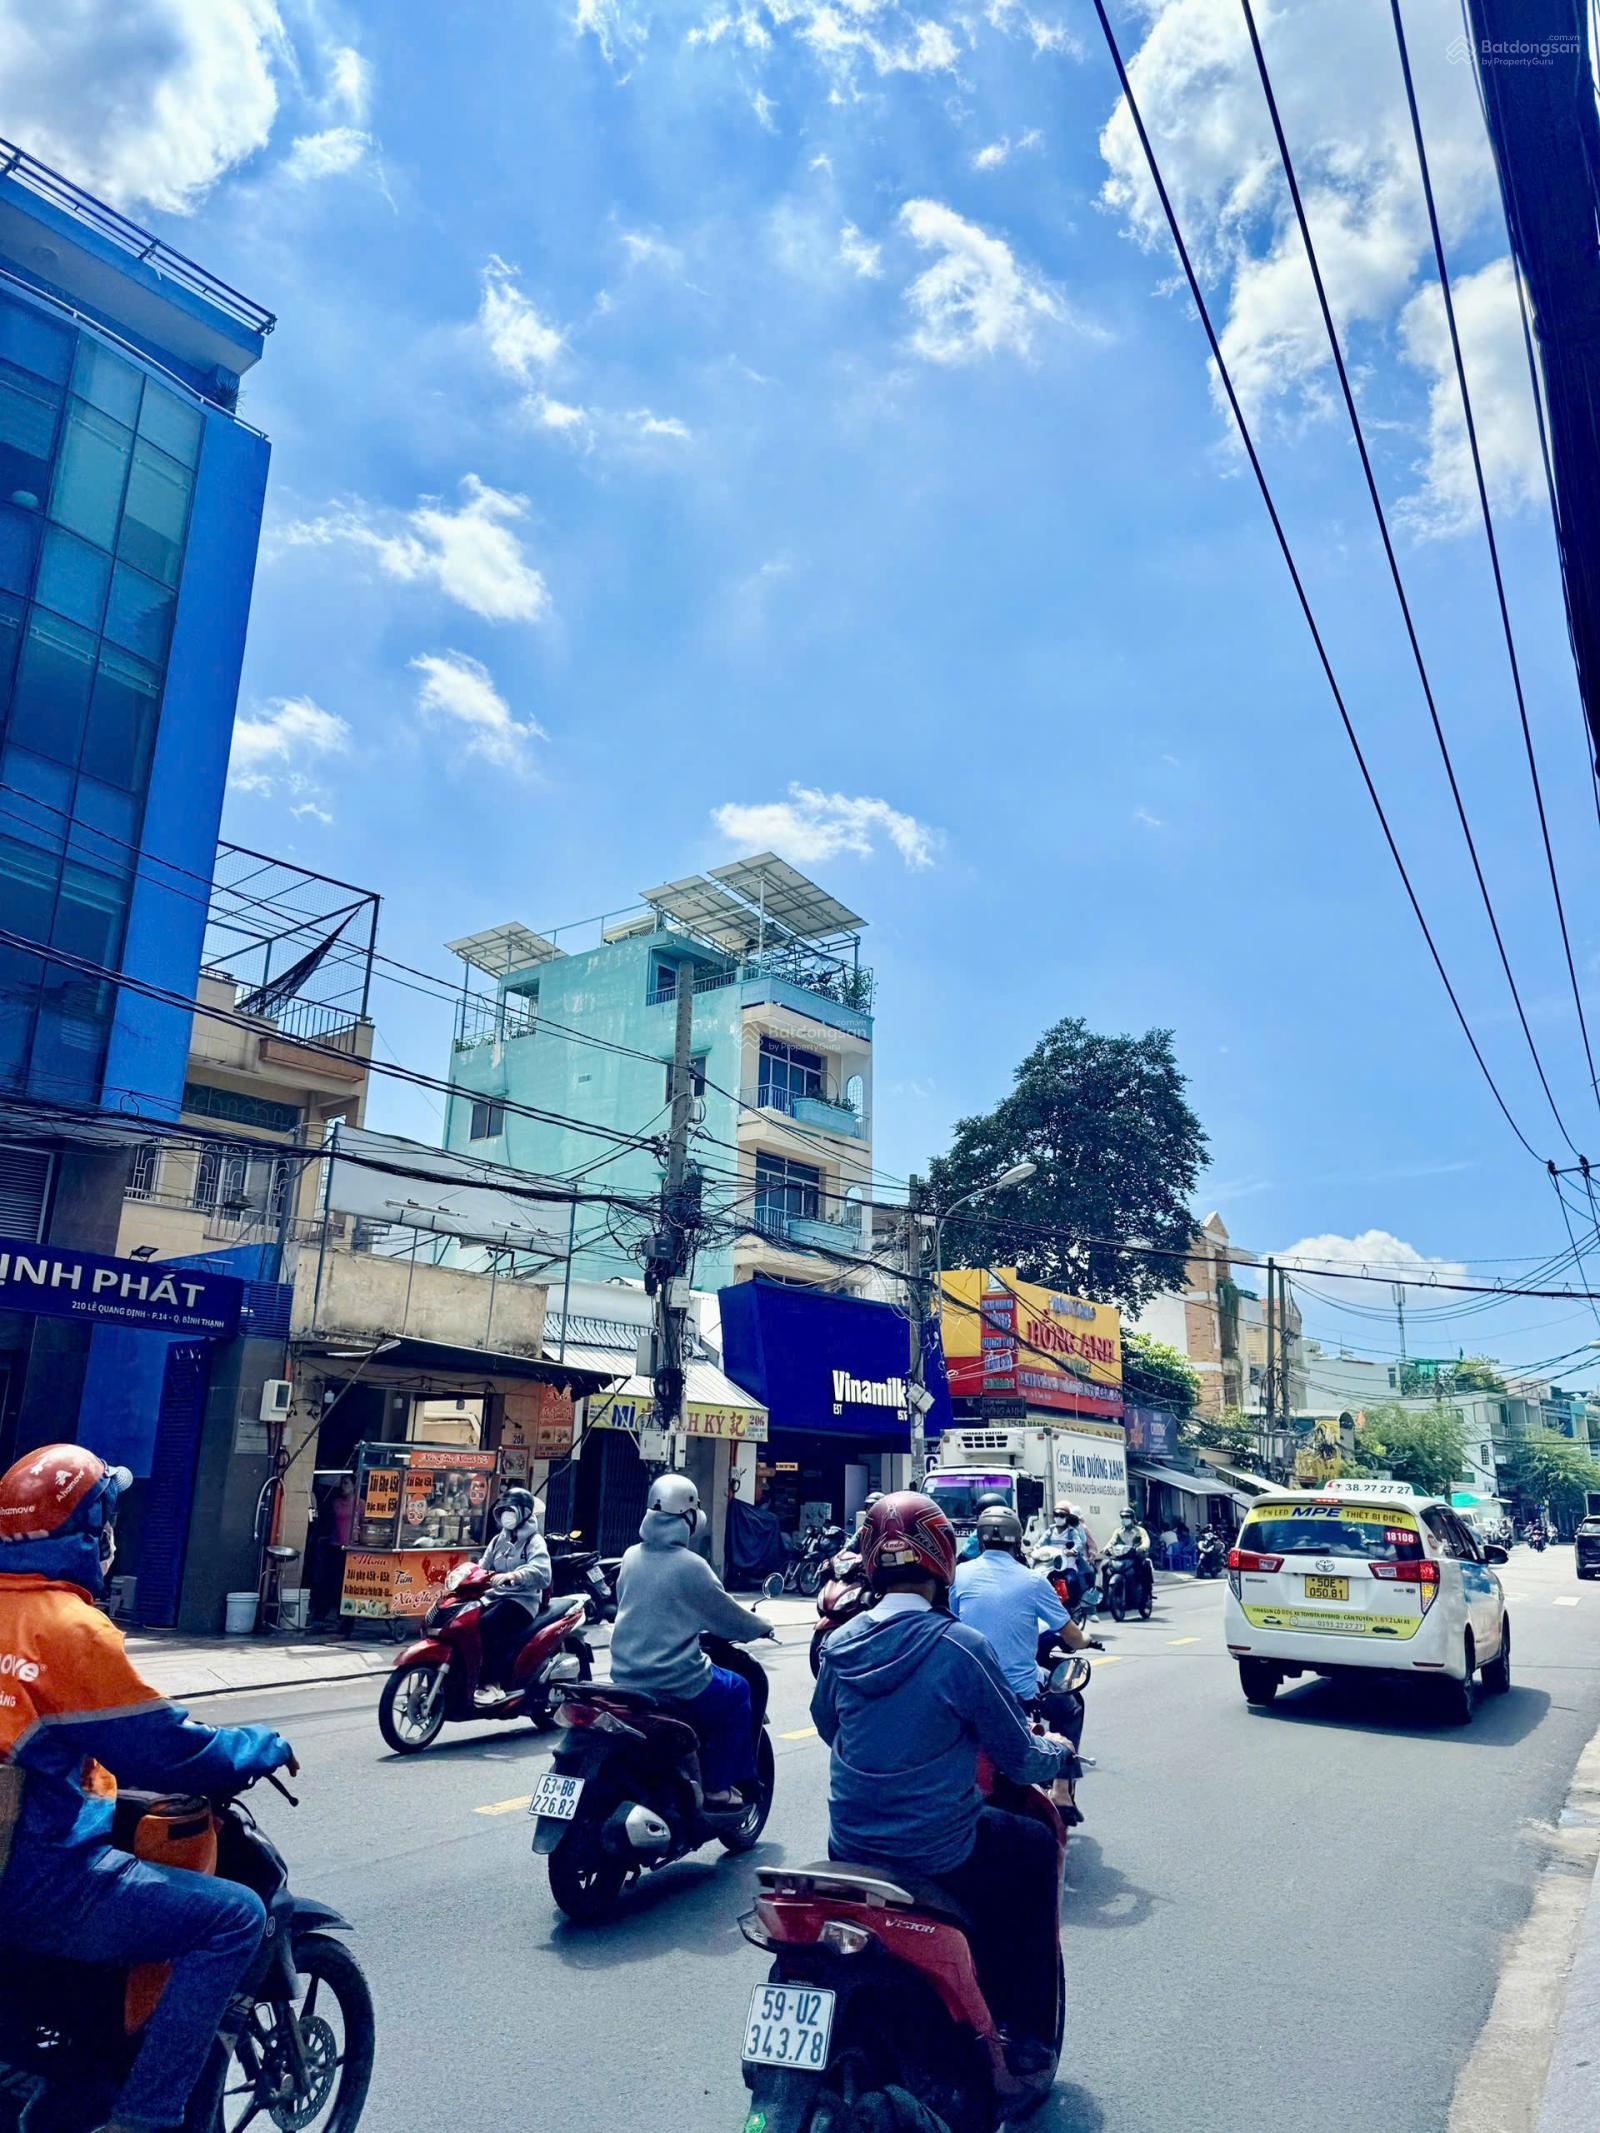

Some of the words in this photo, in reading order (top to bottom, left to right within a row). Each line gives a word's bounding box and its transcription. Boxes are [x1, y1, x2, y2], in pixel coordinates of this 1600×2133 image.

[92, 1268, 205, 1308] PHÁT
[71, 1301, 86, 1310] 210
[98, 1304, 125, 1315] QUANG
[1080, 1333, 1116, 1363] ANH
[832, 1369, 908, 1408] Vinamilk
[611, 1401, 636, 1428] MÌ
[833, 1403, 842, 1415] EST
[704, 1410, 726, 1435] KÝ
[1108, 1459, 1124, 1481] XANH
[56, 1470, 85, 1502] Ahamove
[1380, 1485, 1394, 1494] 27
[1397, 1486, 1411, 1495] 27
[1291, 1507, 1343, 1518] MPE
[1386, 1532, 1414, 1543] 18108
[1309, 1588, 1344, 1598] 050.81
[1316, 1578, 1335, 1588] 50E
[532, 1794, 575, 1817] 226.82
[885, 1918, 936, 1935] VISION
[761, 1989, 822, 2026] 59-U2
[748, 2024, 824, 2064] 343.78
